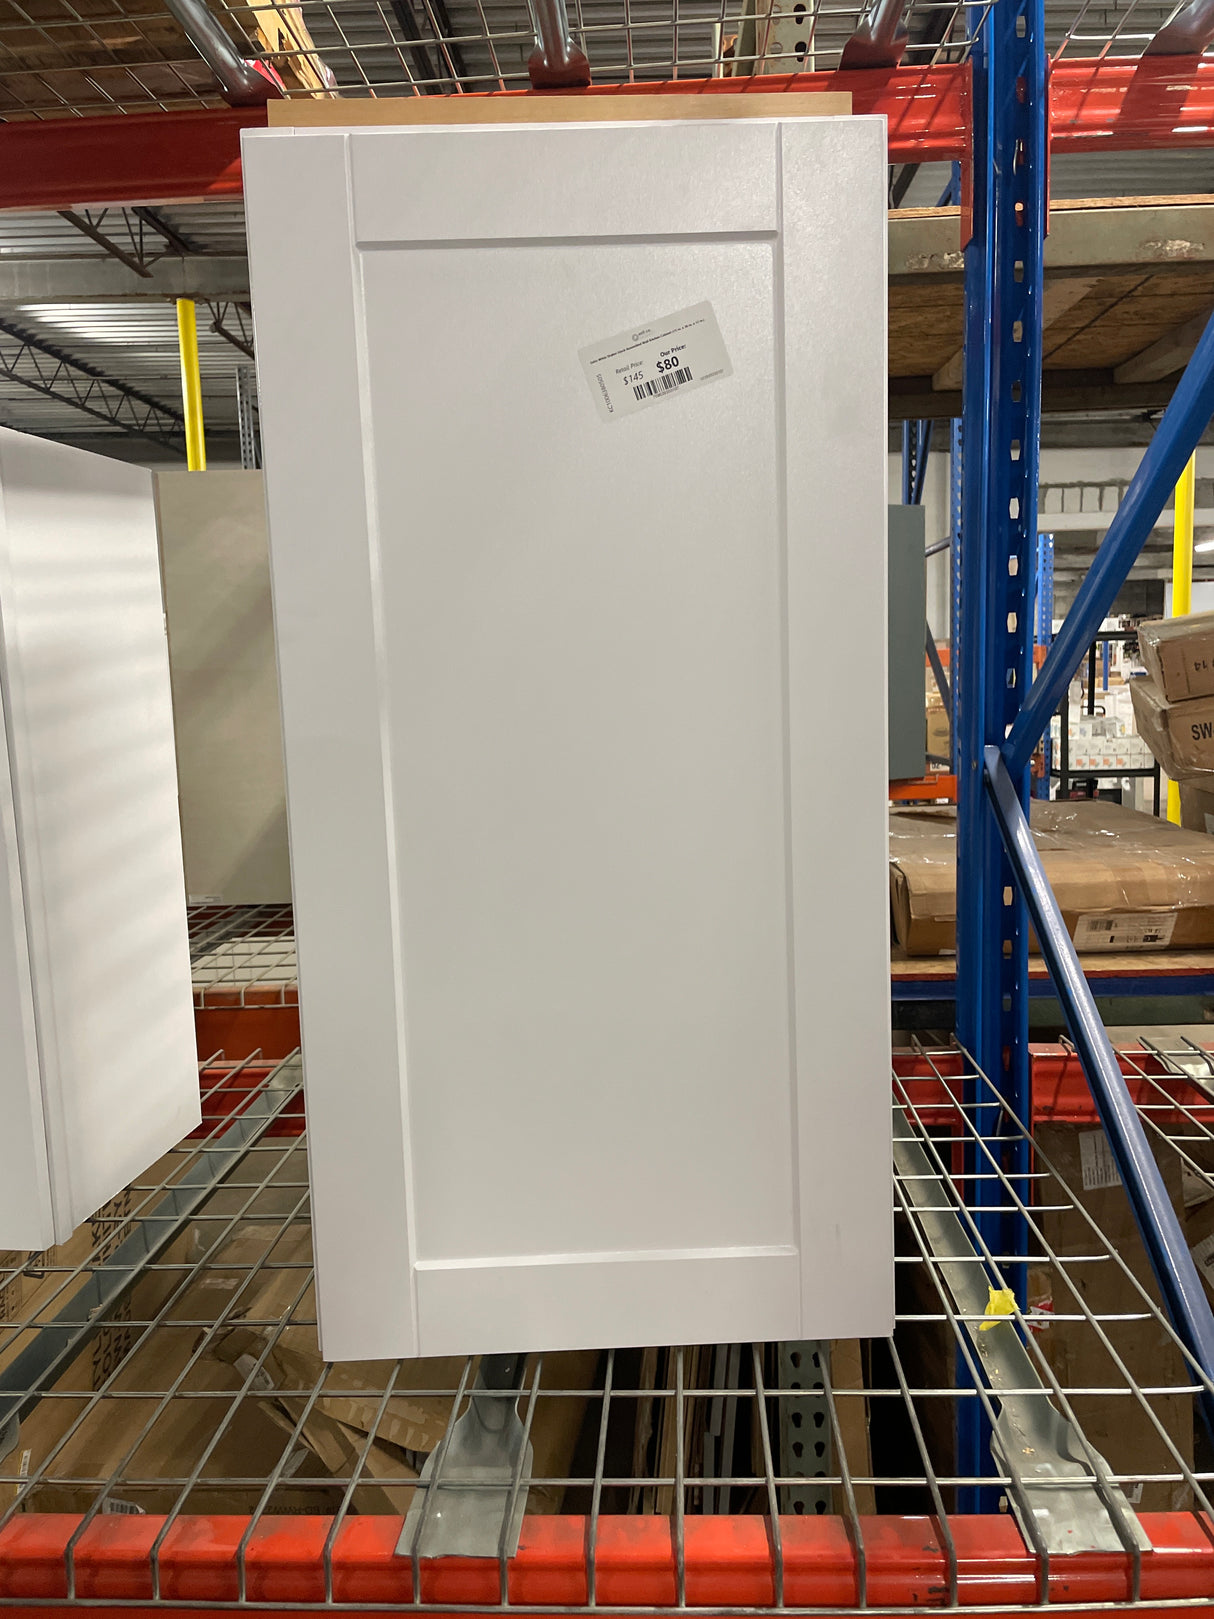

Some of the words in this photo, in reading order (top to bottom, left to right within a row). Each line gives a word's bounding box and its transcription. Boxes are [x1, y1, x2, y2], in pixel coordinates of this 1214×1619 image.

[671, 344, 687, 354] Price:
[615, 365, 630, 374] Retail
[656, 356, 679, 373] $80
[623, 370, 644, 385] $145
